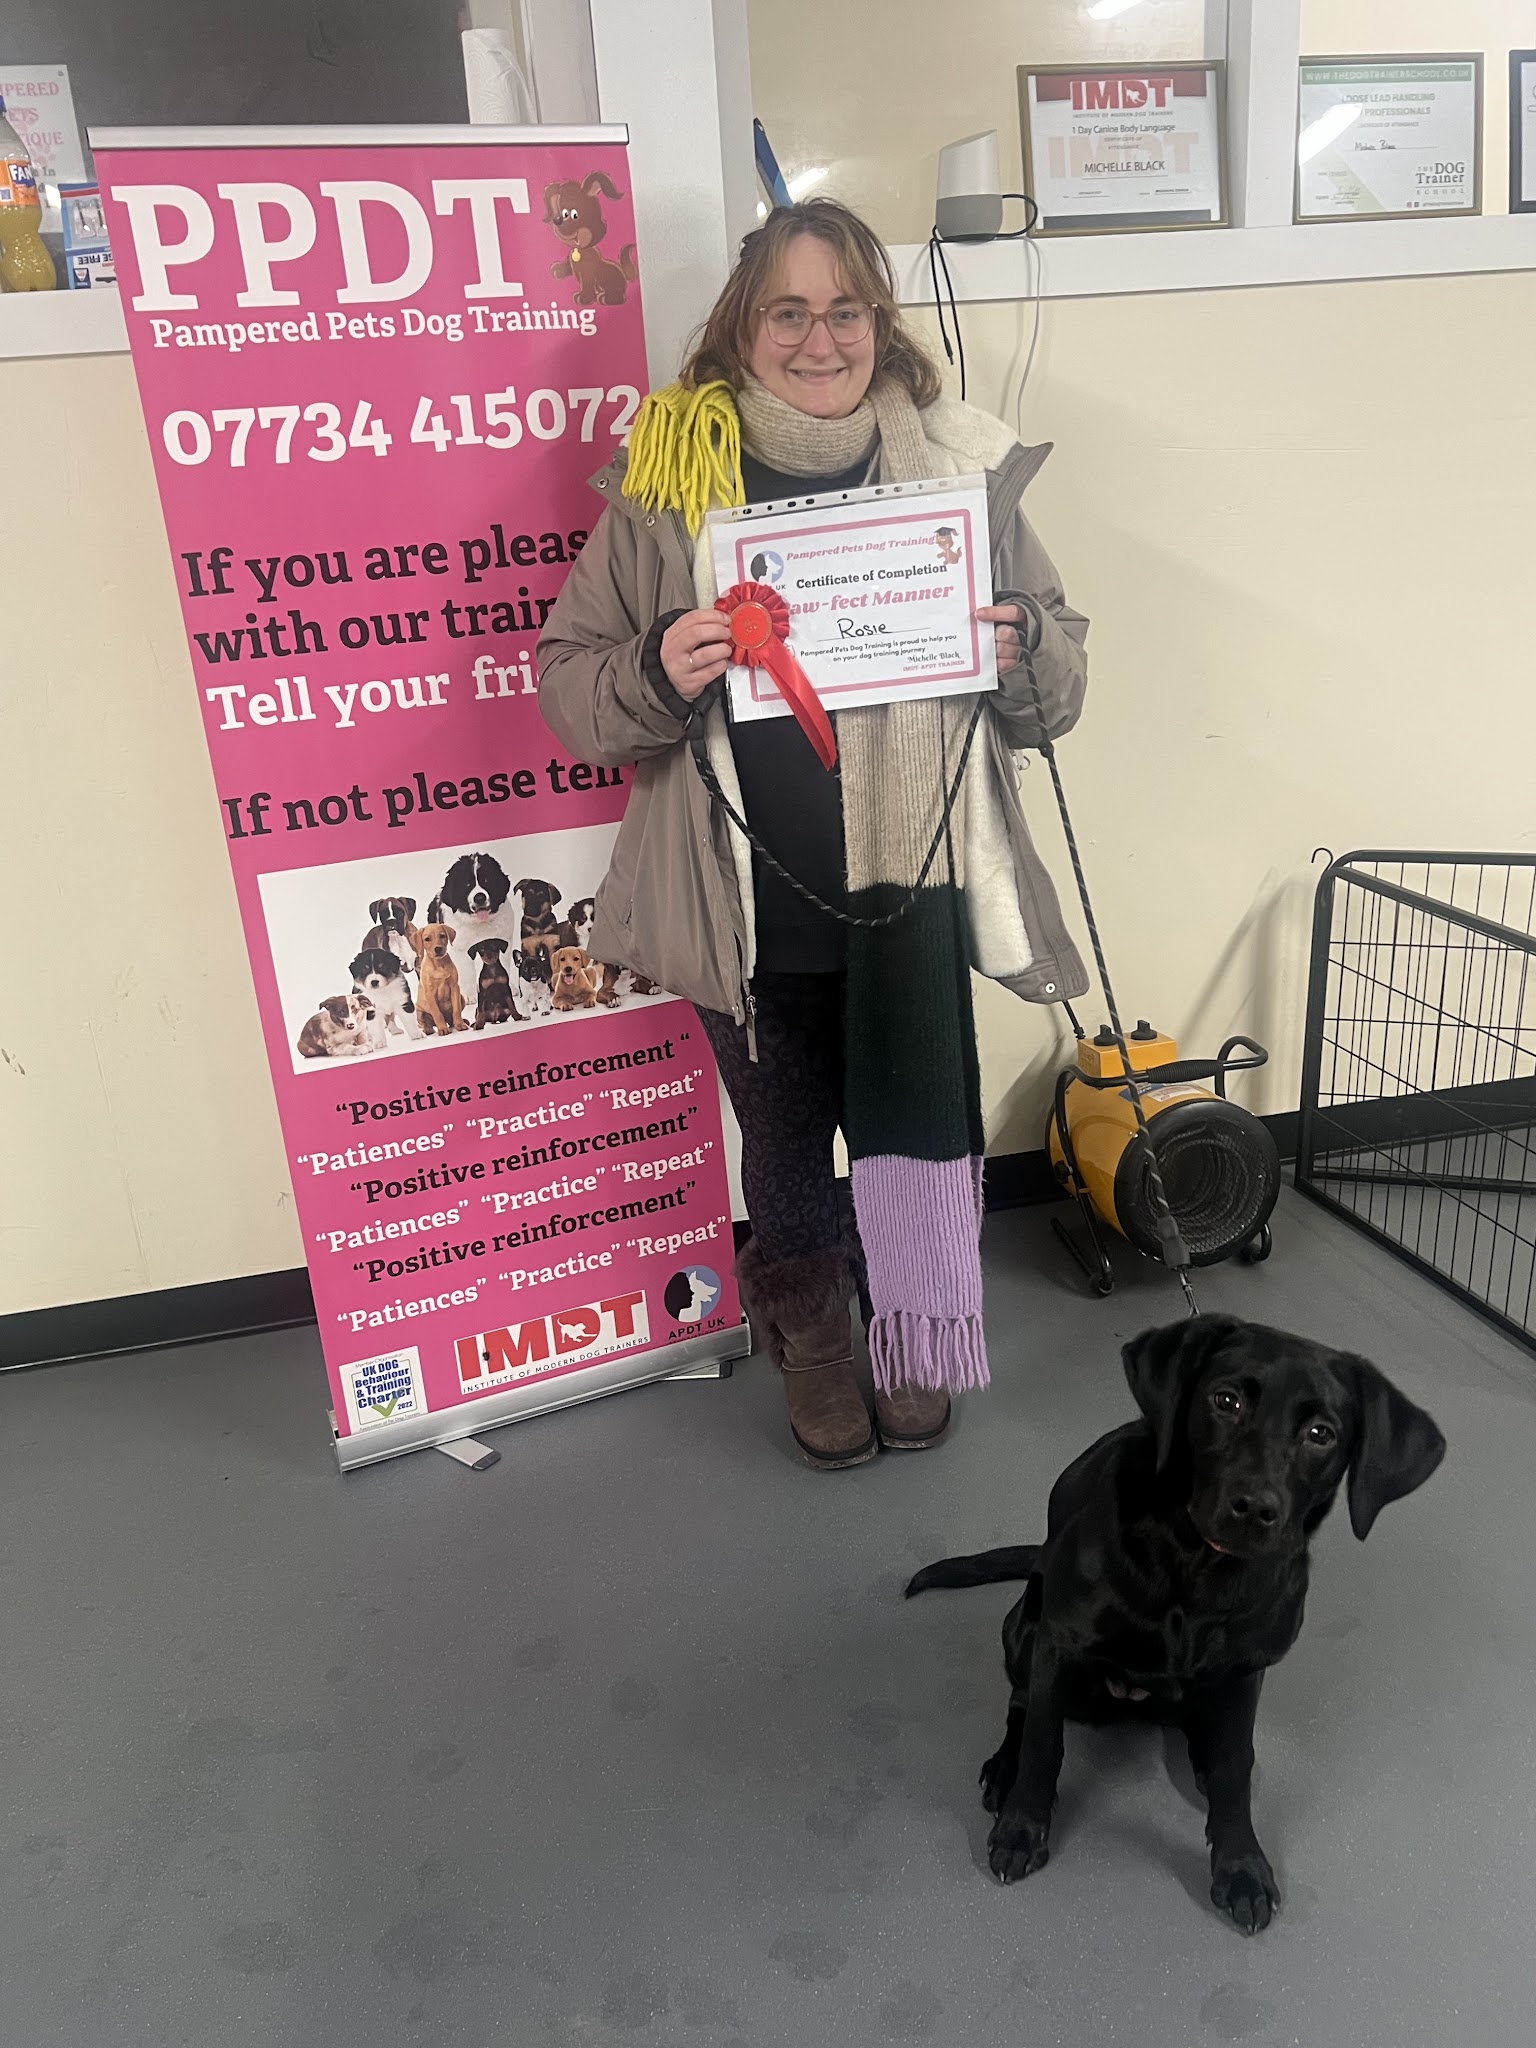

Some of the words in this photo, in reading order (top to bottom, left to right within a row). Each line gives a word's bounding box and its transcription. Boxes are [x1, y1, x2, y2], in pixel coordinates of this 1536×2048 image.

[1072, 79, 1173, 110] IMDT
[1342, 94, 1368, 103] LOOSE
[1370, 94, 1390, 102] LEAD
[1392, 92, 1435, 102] HANDLING
[1365, 107, 1431, 116] PROFESSIONALS
[1078, 125, 1092, 136] Day
[1093, 125, 1118, 134] Canine
[1120, 124, 1139, 134] Body
[1140, 124, 1176, 134] Language
[1084, 161, 1132, 174] MICHELLE
[1135, 160, 1165, 172] BLACK
[1415, 172, 1465, 184] Trainer
[1435, 162, 1465, 174] DOG
[111, 179, 531, 311] PPDT
[150, 312, 321, 352] Pampered
[326, 312, 395, 340] Pets
[401, 309, 464, 342] Dog
[474, 302, 597, 337] Training
[163, 400, 392, 467] 07734
[410, 385, 640, 451] 415072
[786, 546, 839, 561] Pampered
[841, 543, 863, 554] Pets
[865, 541, 886, 552] Dog
[888, 535, 937, 548] Training
[182, 547, 234, 597] If
[245, 552, 352, 603] you
[365, 543, 448, 580] are
[796, 574, 860, 590] Certificate
[862, 570, 875, 581] of
[878, 564, 948, 580] Completion
[786, 593, 869, 616] aw-fect
[873, 584, 954, 605] Manner
[194, 610, 328, 663] with
[340, 611, 429, 649] our
[837, 617, 889, 640] Rosie
[800, 645, 834, 657] Pampered
[835, 644, 849, 653] Pets
[850, 643, 863, 653] Dog
[864, 641, 891, 652] Training
[899, 637, 920, 647] proud
[928, 633, 943, 644] help
[944, 633, 957, 642] you
[842, 653, 858, 663] your
[859, 650, 872, 661] dog
[873, 647, 899, 659] training
[900, 646, 926, 656] journey
[907, 653, 937, 664] Michelle
[938, 651, 962, 661] Black
[206, 676, 316, 731] Tell
[324, 672, 450, 729] your
[472, 651, 540, 700] fri
[223, 792, 272, 839] If
[283, 785, 372, 831] not
[383, 770, 536, 827] please
[478, 1038, 676, 1099] reinforcement
[297, 1124, 454, 1176] “Patiences”
[466, 1093, 593, 1139] “Practice”
[599, 1069, 703, 1110] “Repeat”
[492, 1106, 698, 1175] reinforcement”
[315, 1199, 469, 1253] “Patiences”
[480, 1168, 605, 1214] “Practice”
[611, 1141, 713, 1183] “Repeat”
[492, 1180, 696, 1252] reinforcement”
[337, 1278, 487, 1333] “Patiences”
[498, 1244, 621, 1291] “Practice”
[627, 1215, 726, 1258] “Repeat”
[455, 1291, 645, 1382] IMDT
[668, 1322, 703, 1340] APDT
[708, 1316, 725, 1329] UK
[355, 1367, 409, 1388] Behaviour
[362, 1365, 376, 1377] UK
[378, 1359, 399, 1373] DOG
[463, 1374, 515, 1393] INSTITUTE
[518, 1368, 531, 1379] OF
[535, 1356, 576, 1375] MODERN
[579, 1350, 600, 1361] DOG
[604, 1336, 649, 1354] TRAINERS
[356, 1389, 364, 1398] &
[365, 1376, 411, 1395] Training
[358, 1387, 412, 1408] Charter
[397, 1400, 413, 1410] 2022
